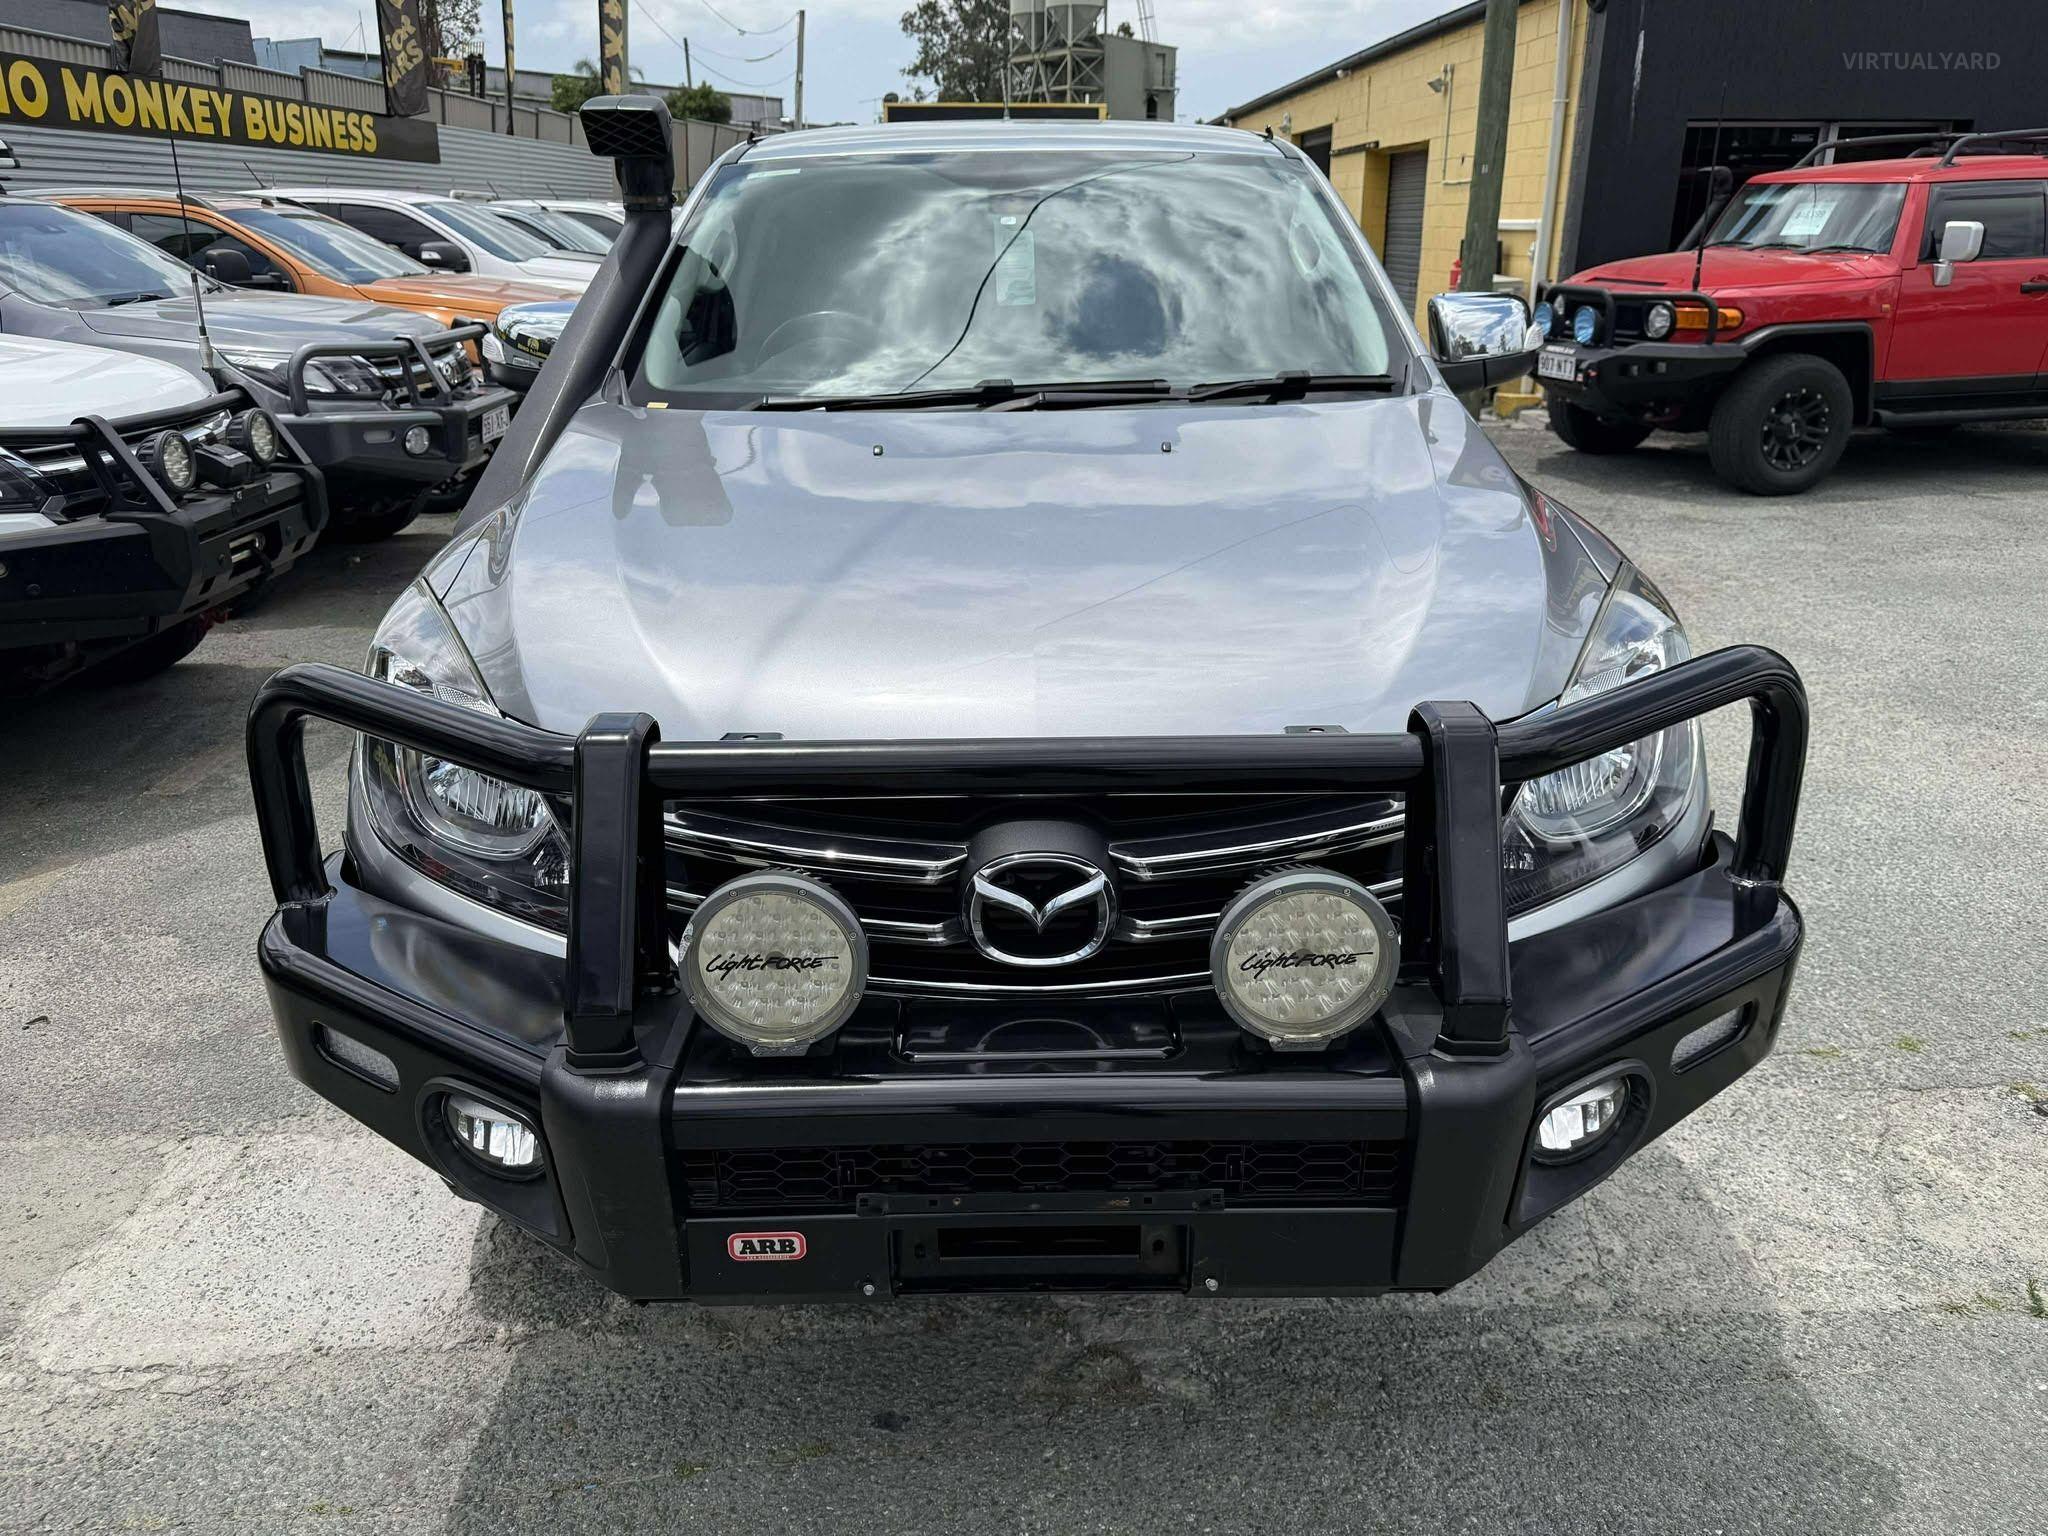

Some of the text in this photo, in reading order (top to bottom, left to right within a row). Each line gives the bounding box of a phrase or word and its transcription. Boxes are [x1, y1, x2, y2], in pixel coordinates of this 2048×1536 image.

[0, 60, 377, 153] O MONKEY BUSINESS
[740, 1239, 797, 1255] ARB
